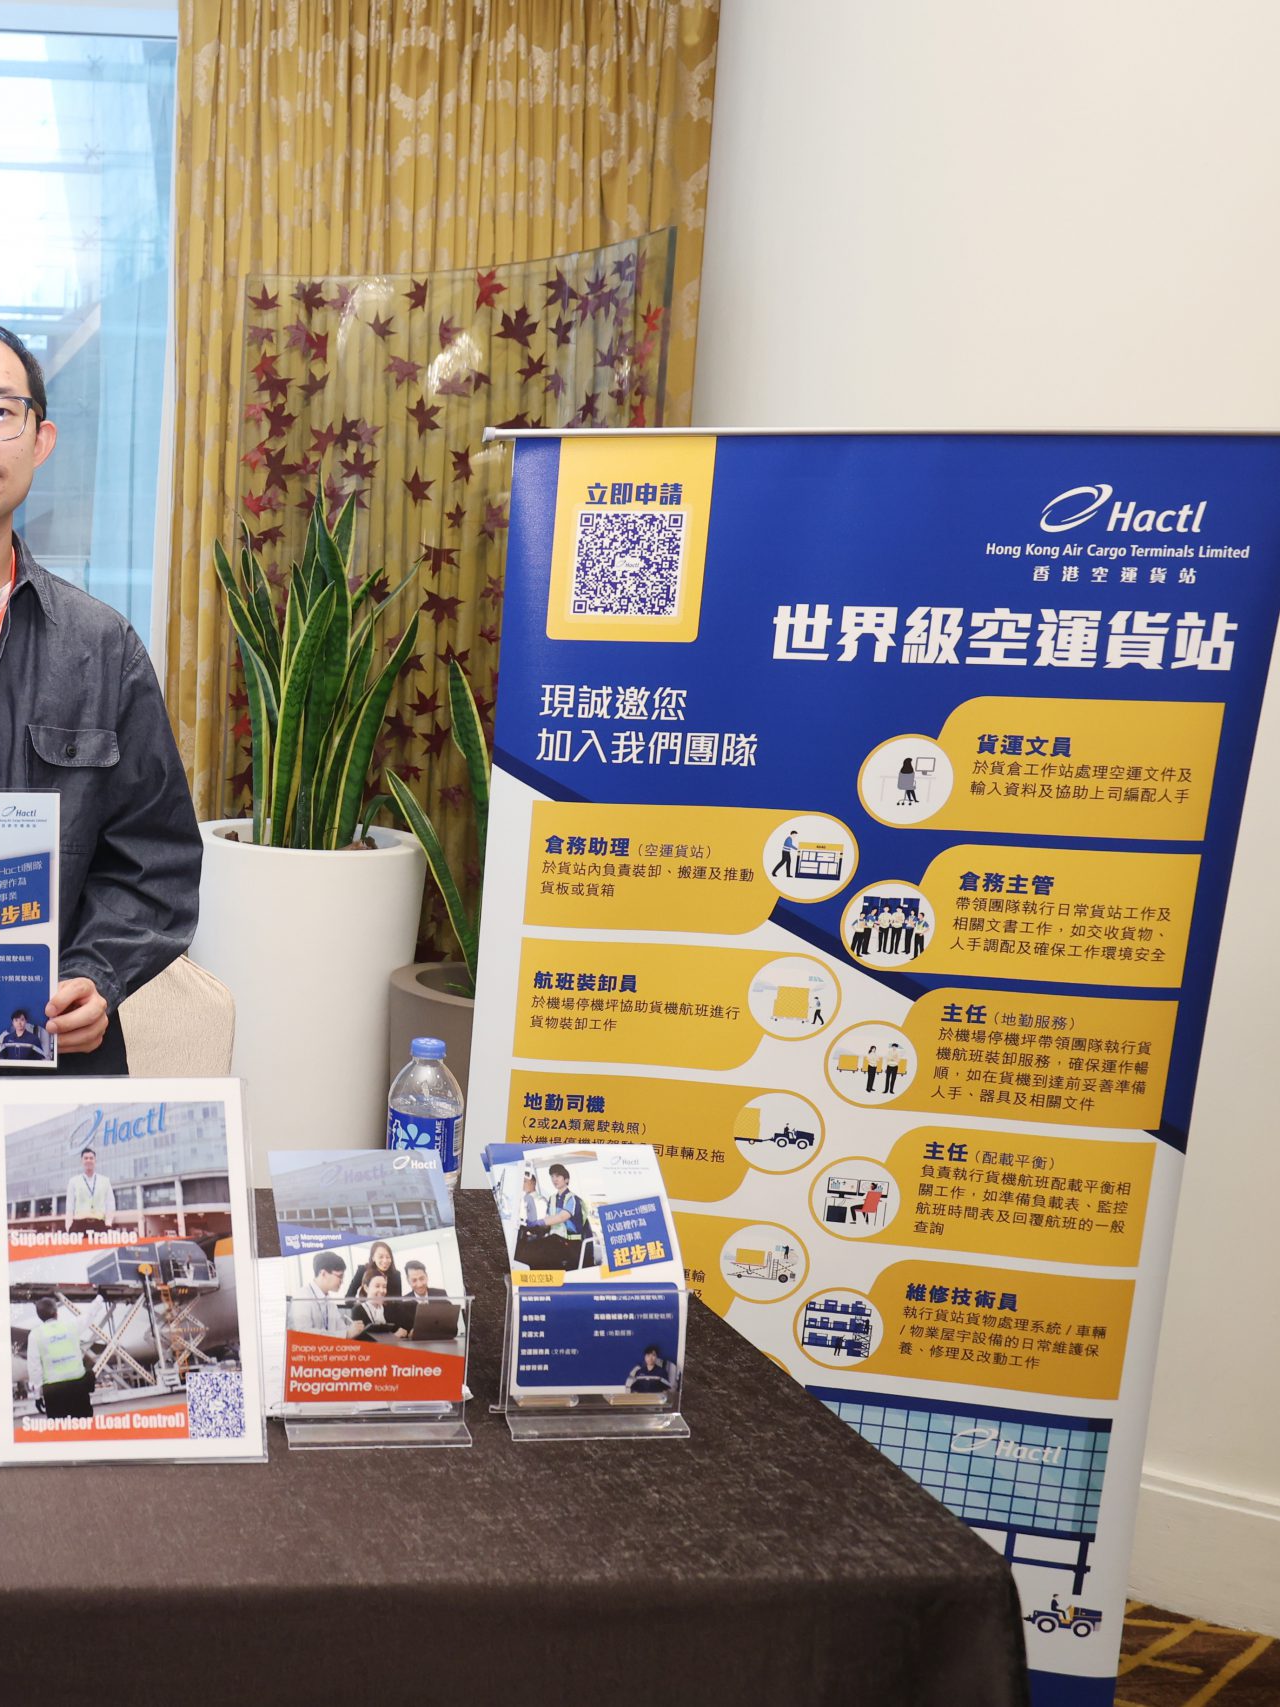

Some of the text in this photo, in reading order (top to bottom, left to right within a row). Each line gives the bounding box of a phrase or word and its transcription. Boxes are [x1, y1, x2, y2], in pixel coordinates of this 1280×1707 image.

[585, 482, 683, 505] 立即申請
[1106, 500, 1207, 533] Hactl
[986, 543, 1250, 559] Hong Kong Air Cargo Terminals Limited
[1033, 565, 1197, 584] 香港空運貨站
[772, 603, 1239, 671] 世界級空運貨站
[538, 684, 688, 721] 現誠邀您
[535, 727, 758, 767] 加入我們團隊
[976, 733, 1072, 757] 貨運文員
[972, 759, 1193, 783] 於貨倉工作站處理空運文件及
[970, 780, 1190, 804] 輸入資料及協助上司編配人手
[16, 809, 37, 817] Hactl
[540, 881, 615, 898] 貨板或貨箱
[958, 871, 1056, 896] 倉務主管
[955, 896, 1171, 922] 帶領團隊執行日常貨站工作及
[950, 936, 1166, 962] 人手調配及確保工作環境安全
[533, 970, 638, 994] 航班裝卸員
[531, 995, 740, 1021] 於機場停機坪協助貨機航班進行
[530, 1015, 617, 1032] 貨物裝卸工作
[938, 1026, 1152, 1056] 於機場停機坪帶領團隊執行貨
[523, 1092, 606, 1114] 地勤司機
[103, 1103, 167, 1146] Hactl
[411, 1160, 437, 1169] Hactl
[920, 1164, 1132, 1196] 負責執行貨機航班配載平衡相
[913, 1221, 944, 1236] 查詢
[915, 1201, 1126, 1235] 航班時間表及回覆航班的一般
[10, 1230, 138, 1247] Supervisor Trainee
[613, 1240, 665, 1267] 起步點
[905, 1282, 1019, 1313] 維修技術員
[317, 1345, 334, 1353] your
[898, 1341, 1040, 1370] 養、修理及改動工作
[290, 1364, 442, 1381] Management Trainee
[289, 1380, 372, 1395] Programme
[22, 1412, 185, 1432] Supervisor (Load Control)
[994, 1439, 1064, 1465] Hactl
